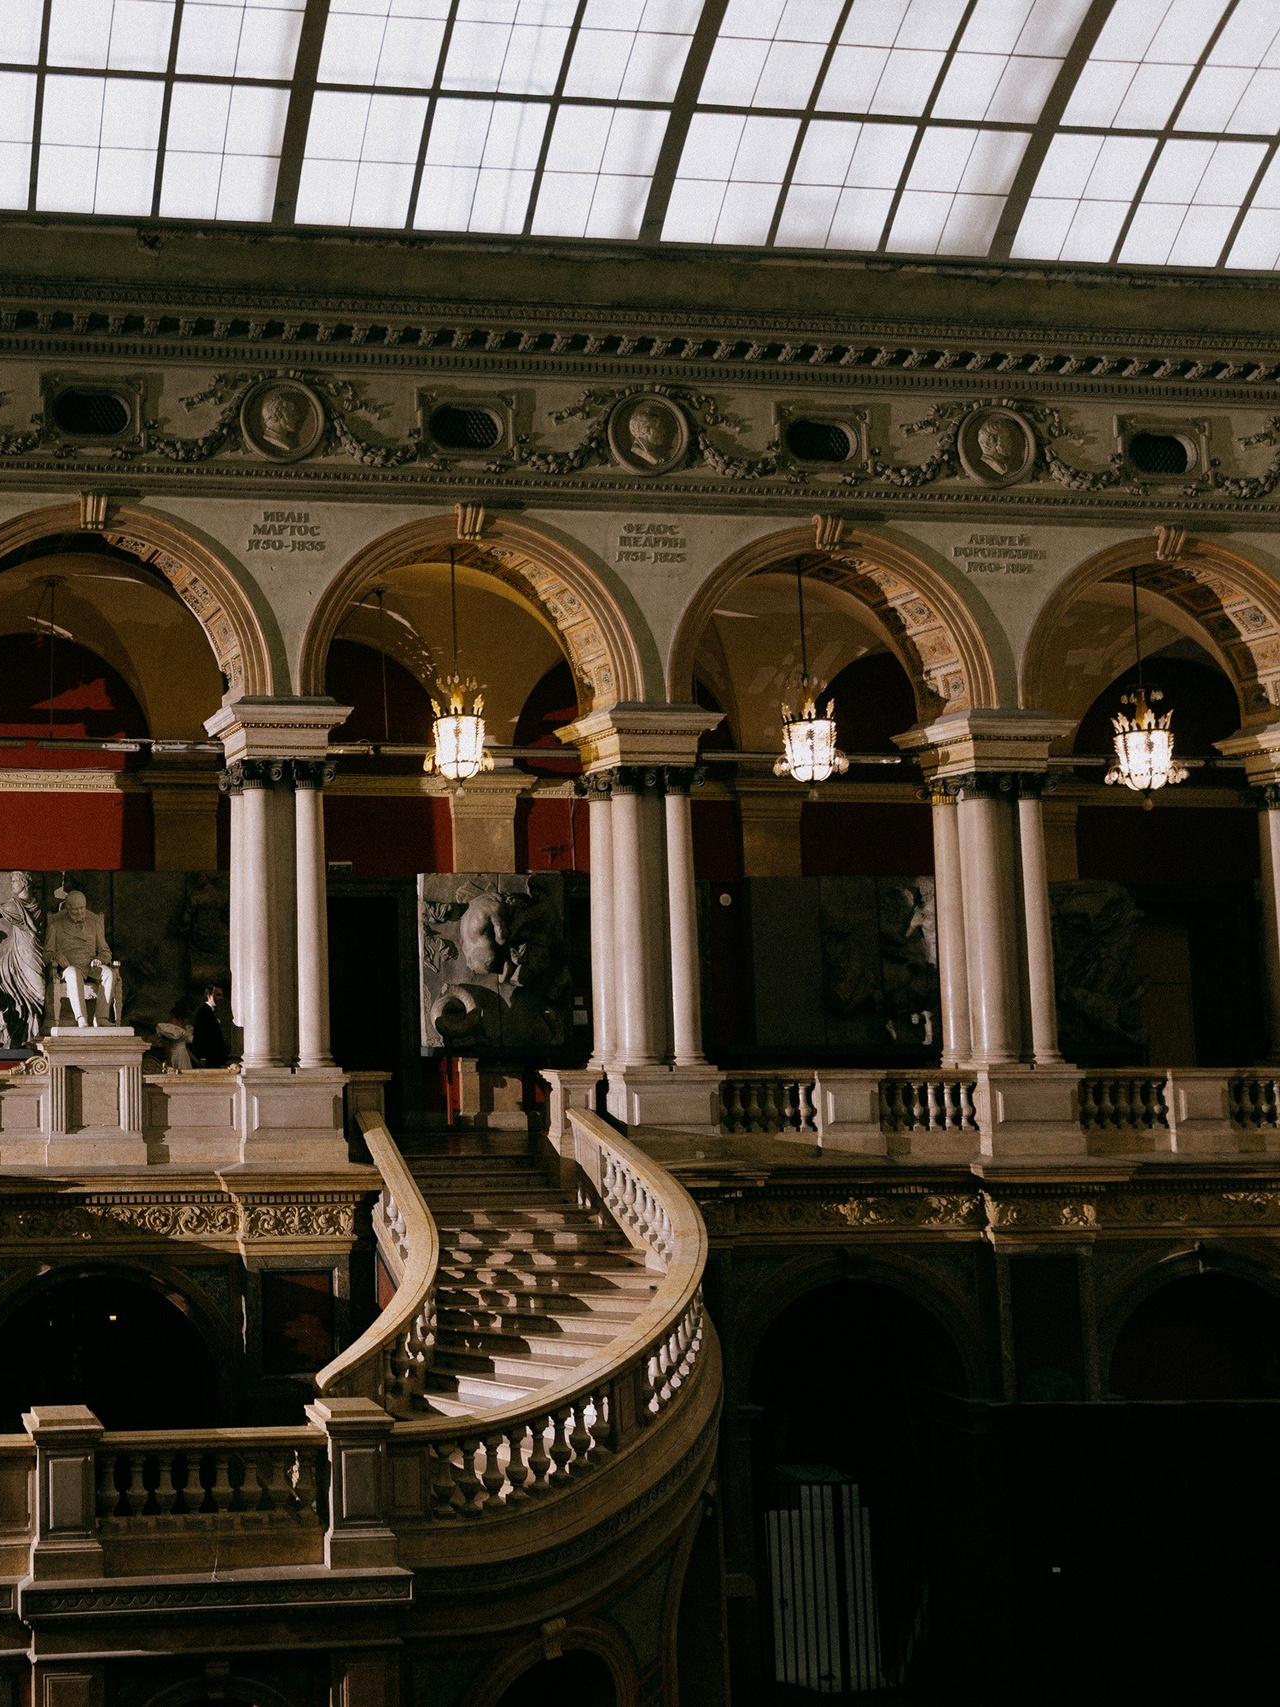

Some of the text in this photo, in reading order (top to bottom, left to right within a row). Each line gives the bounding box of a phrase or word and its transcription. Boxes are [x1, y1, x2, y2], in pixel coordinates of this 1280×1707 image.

[262, 511, 310, 524] ИВАН
[252, 523, 321, 537] МАРТОС
[622, 523, 680, 536] ФЕДОС
[619, 535, 687, 549] ЩЕДРИН
[967, 533, 1032, 547] АНДРЕЙ
[952, 546, 1048, 560] ВОРОНИХИН
